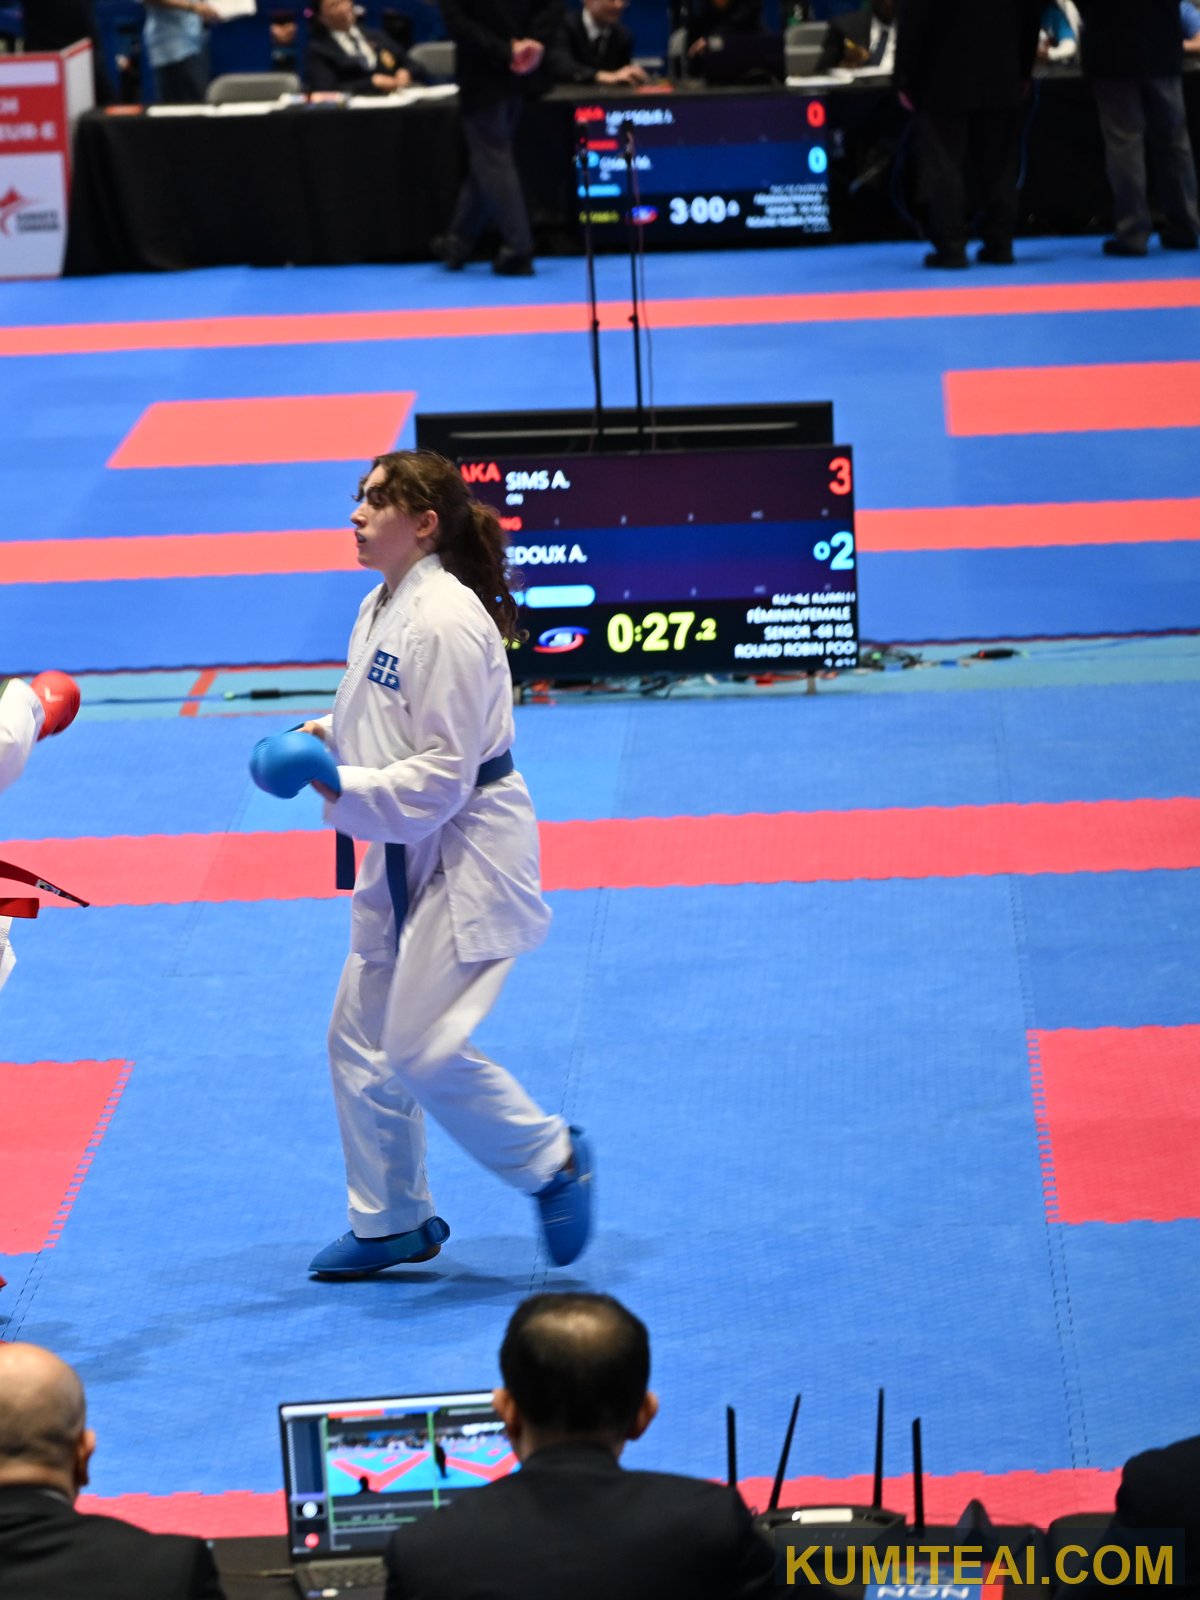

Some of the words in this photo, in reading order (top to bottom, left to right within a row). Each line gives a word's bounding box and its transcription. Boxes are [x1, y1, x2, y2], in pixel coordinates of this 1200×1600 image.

[807, 101, 826, 128] 0
[808, 146, 828, 174] 0
[505, 470, 550, 491] SIMS
[551, 470, 571, 489] A.
[829, 457, 852, 496] 3
[568, 543, 588, 564] A.
[763, 625, 811, 641] SENIOR
[834, 622, 854, 639] KG
[734, 643, 783, 659] ROUND
[783, 641, 825, 658] ROBIN
